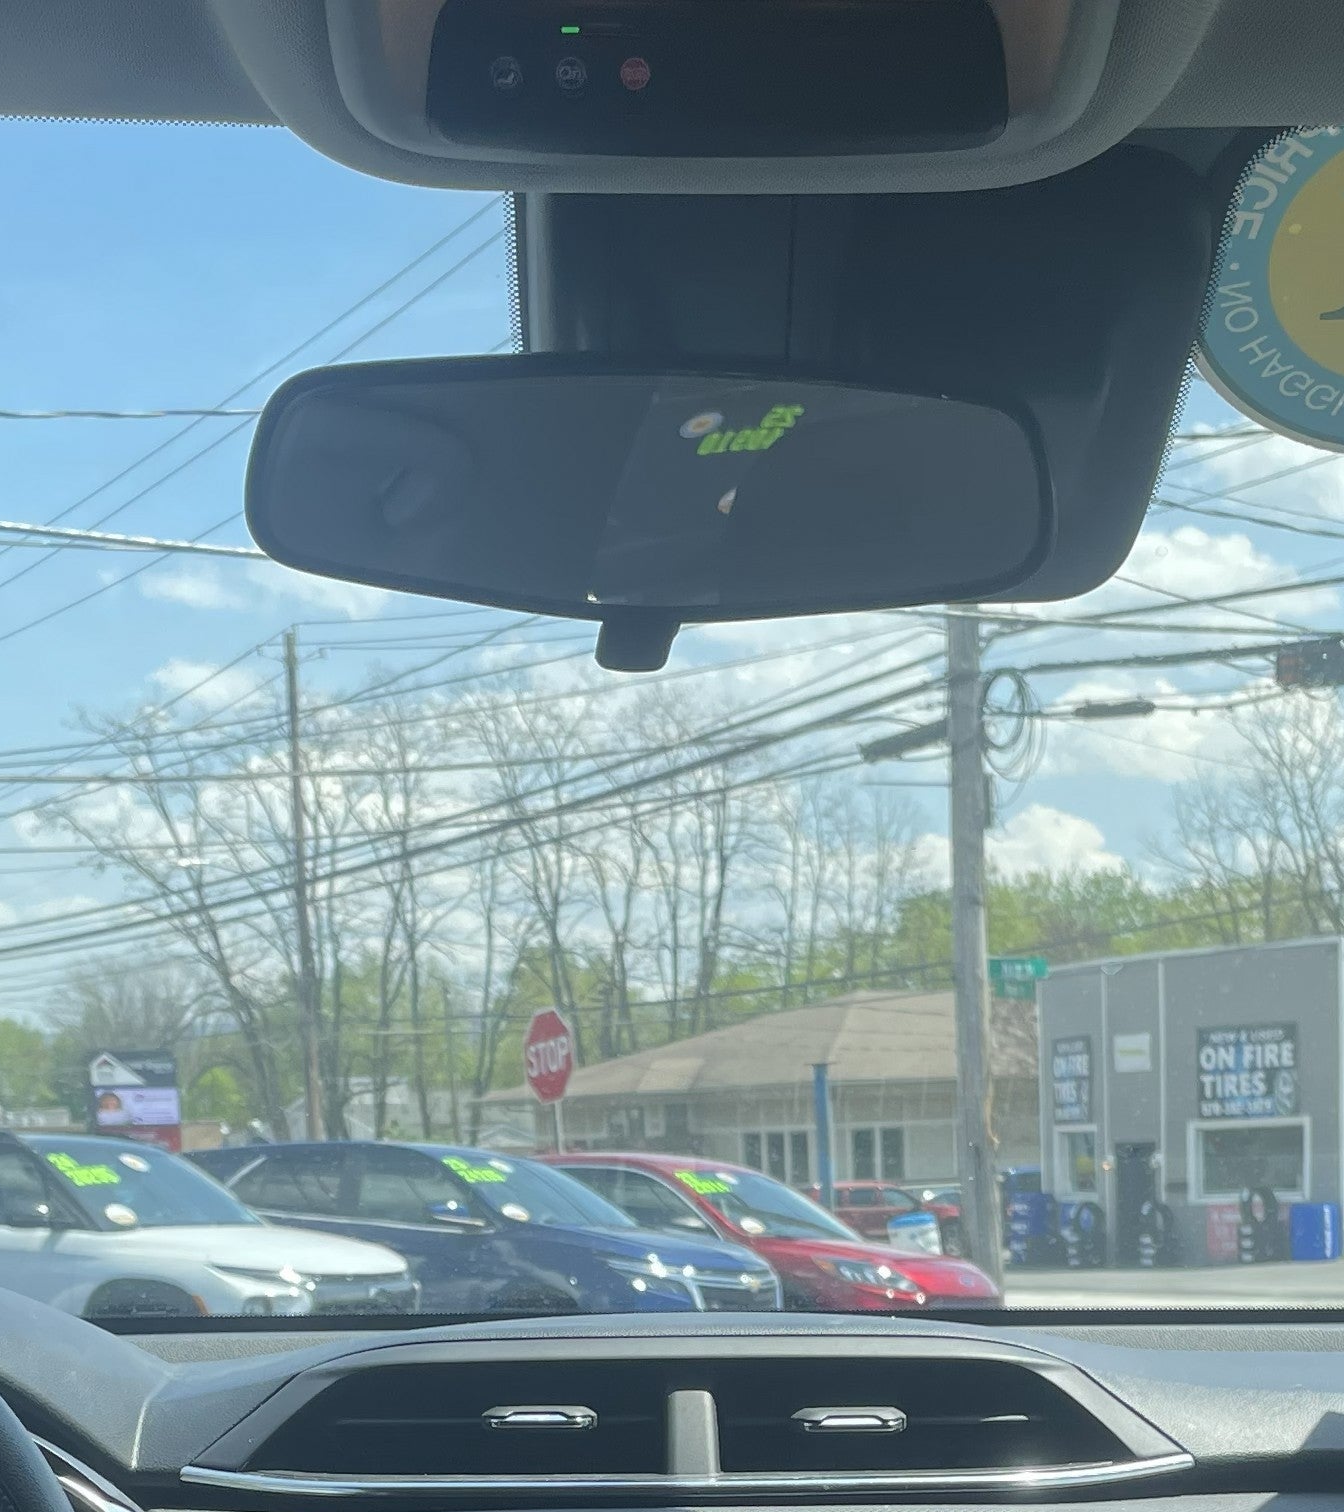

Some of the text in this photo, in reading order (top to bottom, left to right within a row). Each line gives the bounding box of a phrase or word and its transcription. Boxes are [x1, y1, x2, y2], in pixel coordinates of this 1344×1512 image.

[525, 1038, 571, 1080] STOP
[1199, 1041, 1295, 1070] ON FIRE
[1199, 1071, 1267, 1099] TIRES
